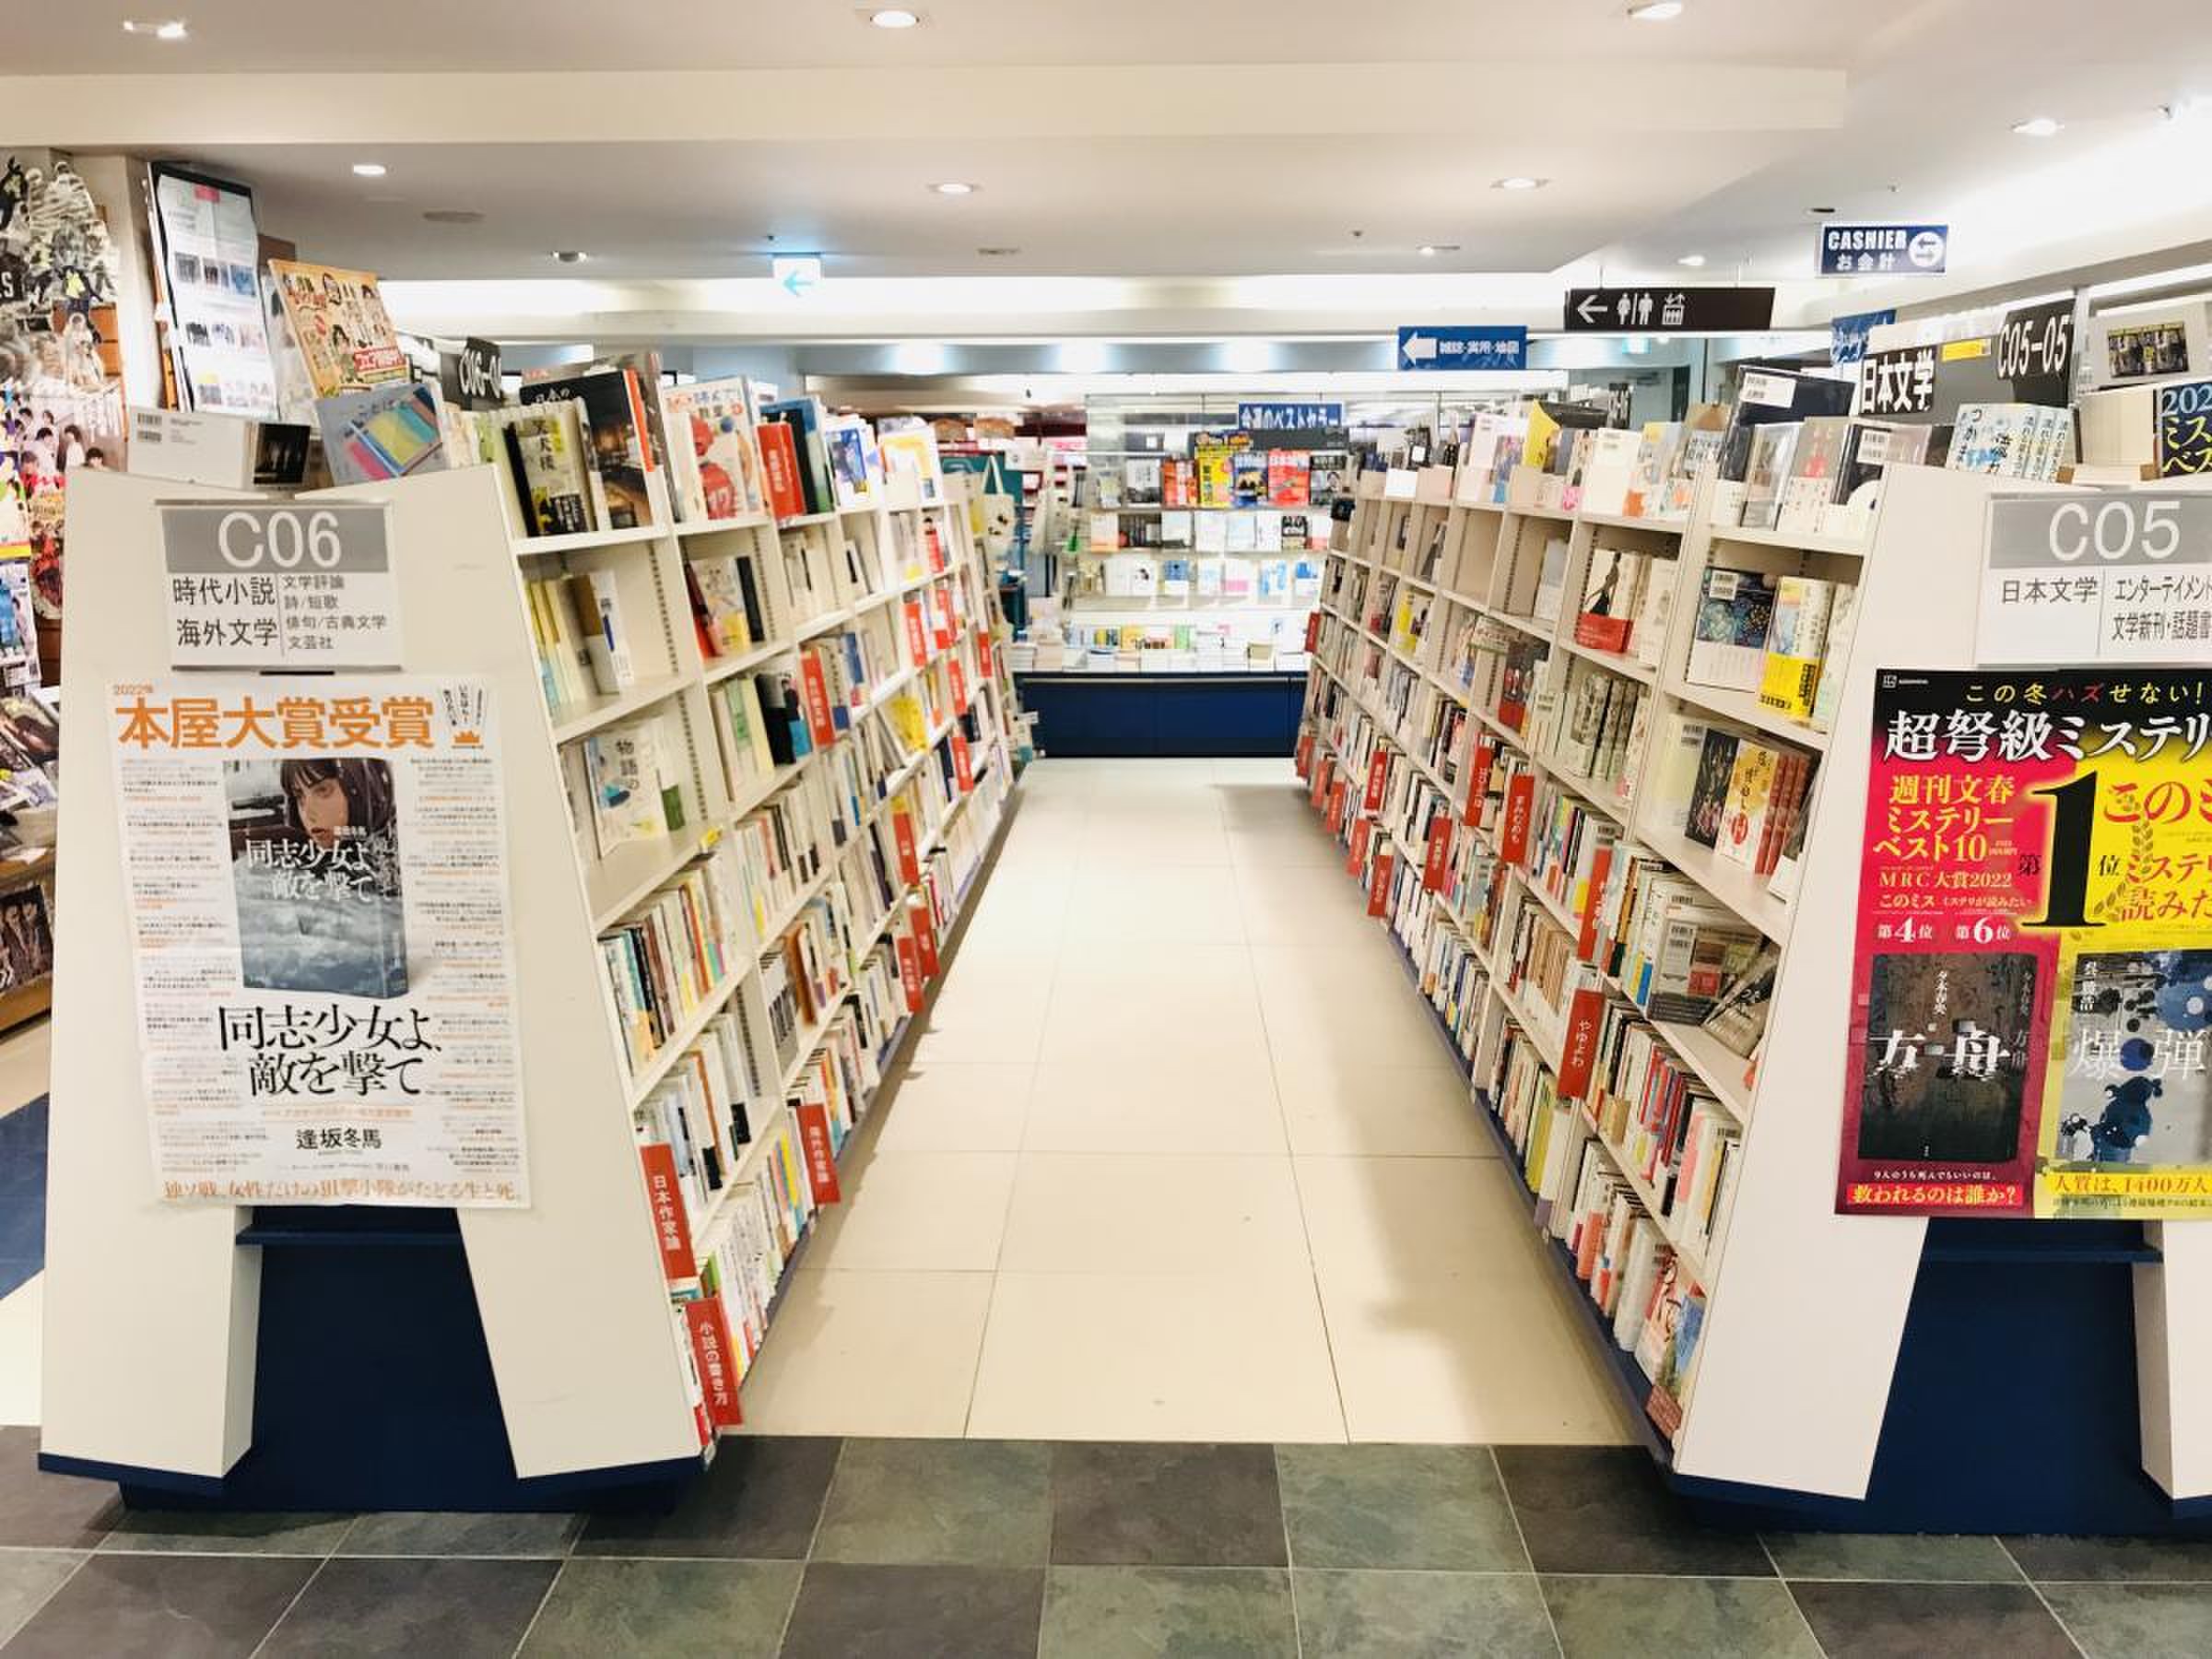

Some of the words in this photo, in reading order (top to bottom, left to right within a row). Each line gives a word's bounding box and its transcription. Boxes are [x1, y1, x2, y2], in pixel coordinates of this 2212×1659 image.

[1829, 229, 1907, 250] CASHIER
[1836, 253, 1895, 270] お会計
[1997, 313, 2071, 378] C05-05
[1862, 348, 1935, 412] 日本文学
[218, 512, 341, 568] C06
[2049, 500, 2182, 560] C05
[171, 576, 276, 606] 時代小説
[283, 575, 345, 589] 文学評論
[2002, 576, 2098, 604] 日本文学
[284, 595, 339, 610] 詩/短歌
[176, 618, 277, 648] 海外文学
[288, 635, 335, 650] 文芸社
[115, 697, 434, 749] 本屋大賞受賞
[1889, 774, 2016, 805] 週刊文春
[1888, 806, 2014, 834] ミステリー
[1873, 832, 1987, 862] ベスト10
[2125, 853, 2212, 885] ミステ
[272, 869, 372, 902] 敵を撃て
[1879, 894, 1936, 909] このミス
[1877, 916, 1933, 943] 第4位
[1956, 916, 2011, 944] 第6位
[218, 1004, 441, 1052] 同志少女よ、
[1867, 1029, 2011, 1082] 方舟
[248, 1050, 424, 1097] 敵を撃て
[296, 1128, 382, 1150] 逢坂冬馬
